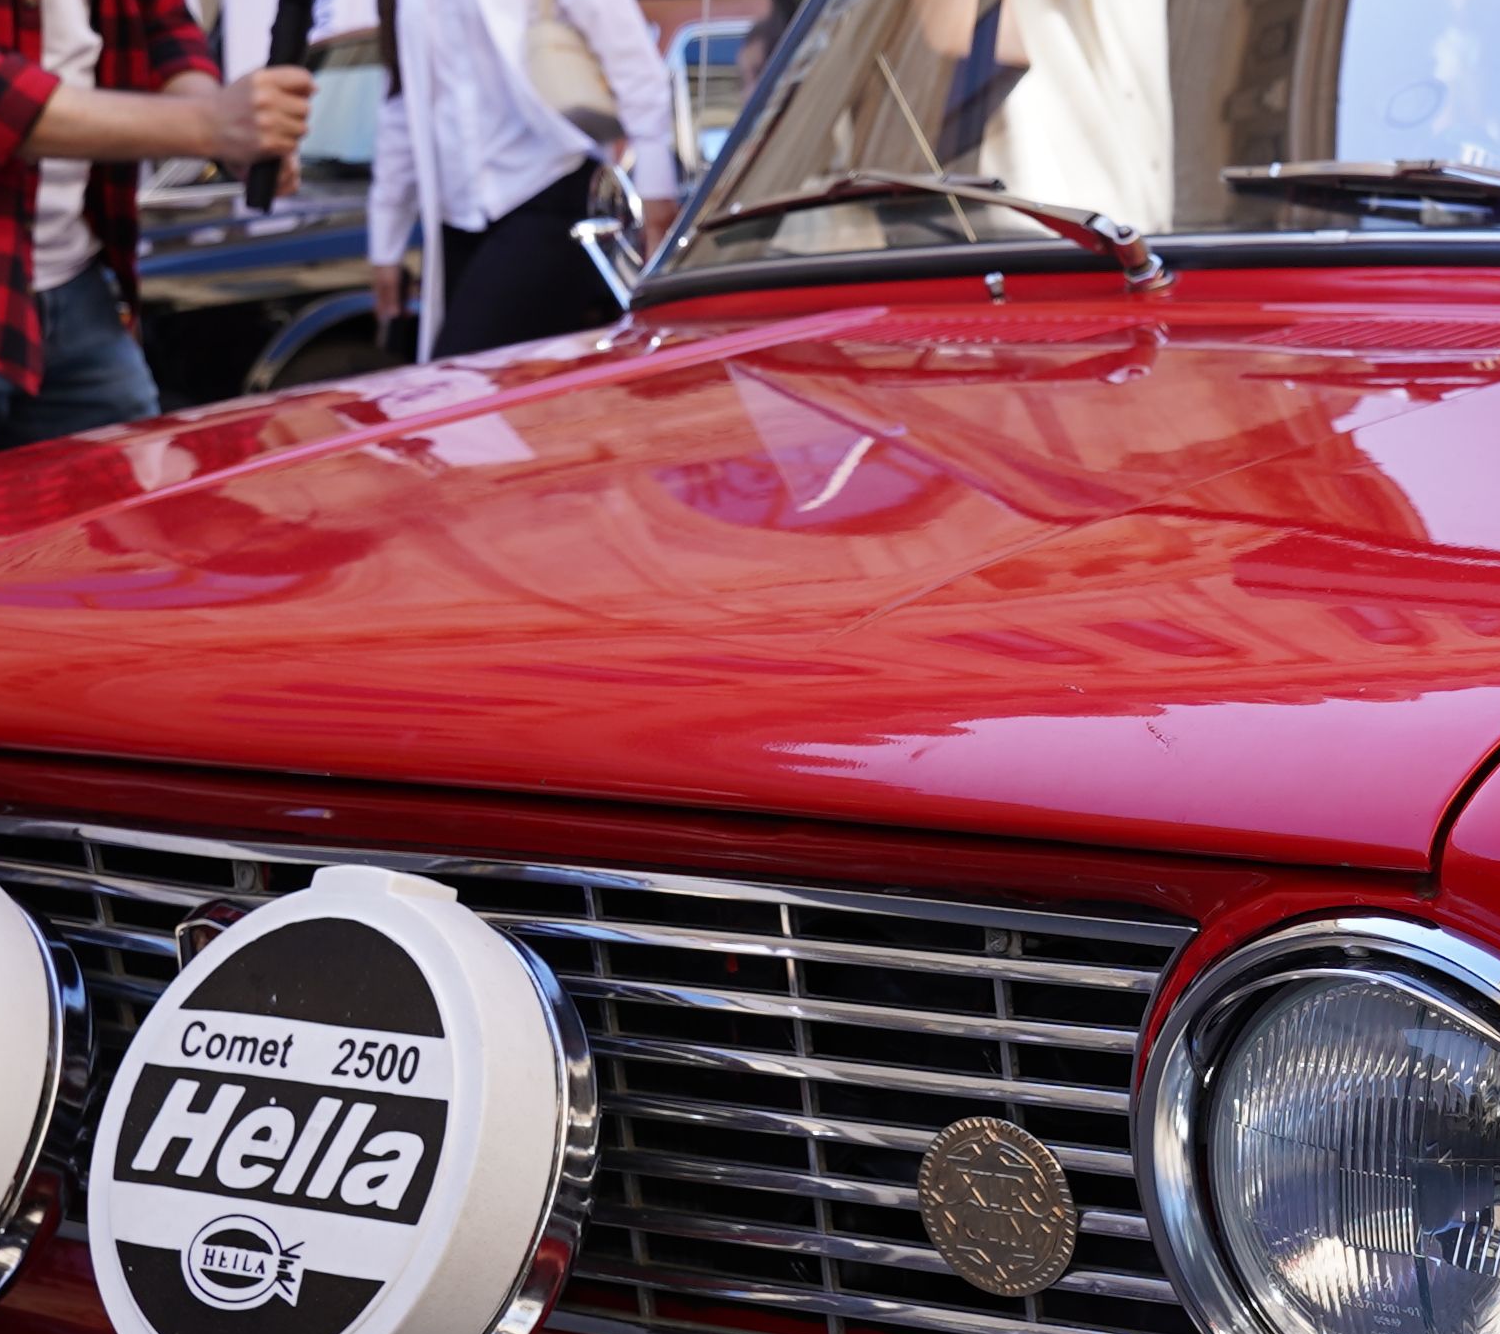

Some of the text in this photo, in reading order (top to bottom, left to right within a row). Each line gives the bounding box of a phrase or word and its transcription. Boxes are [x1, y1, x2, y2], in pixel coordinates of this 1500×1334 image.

[181, 1020, 421, 1085] Comet 2500
[132, 1077, 427, 1212] Hella
